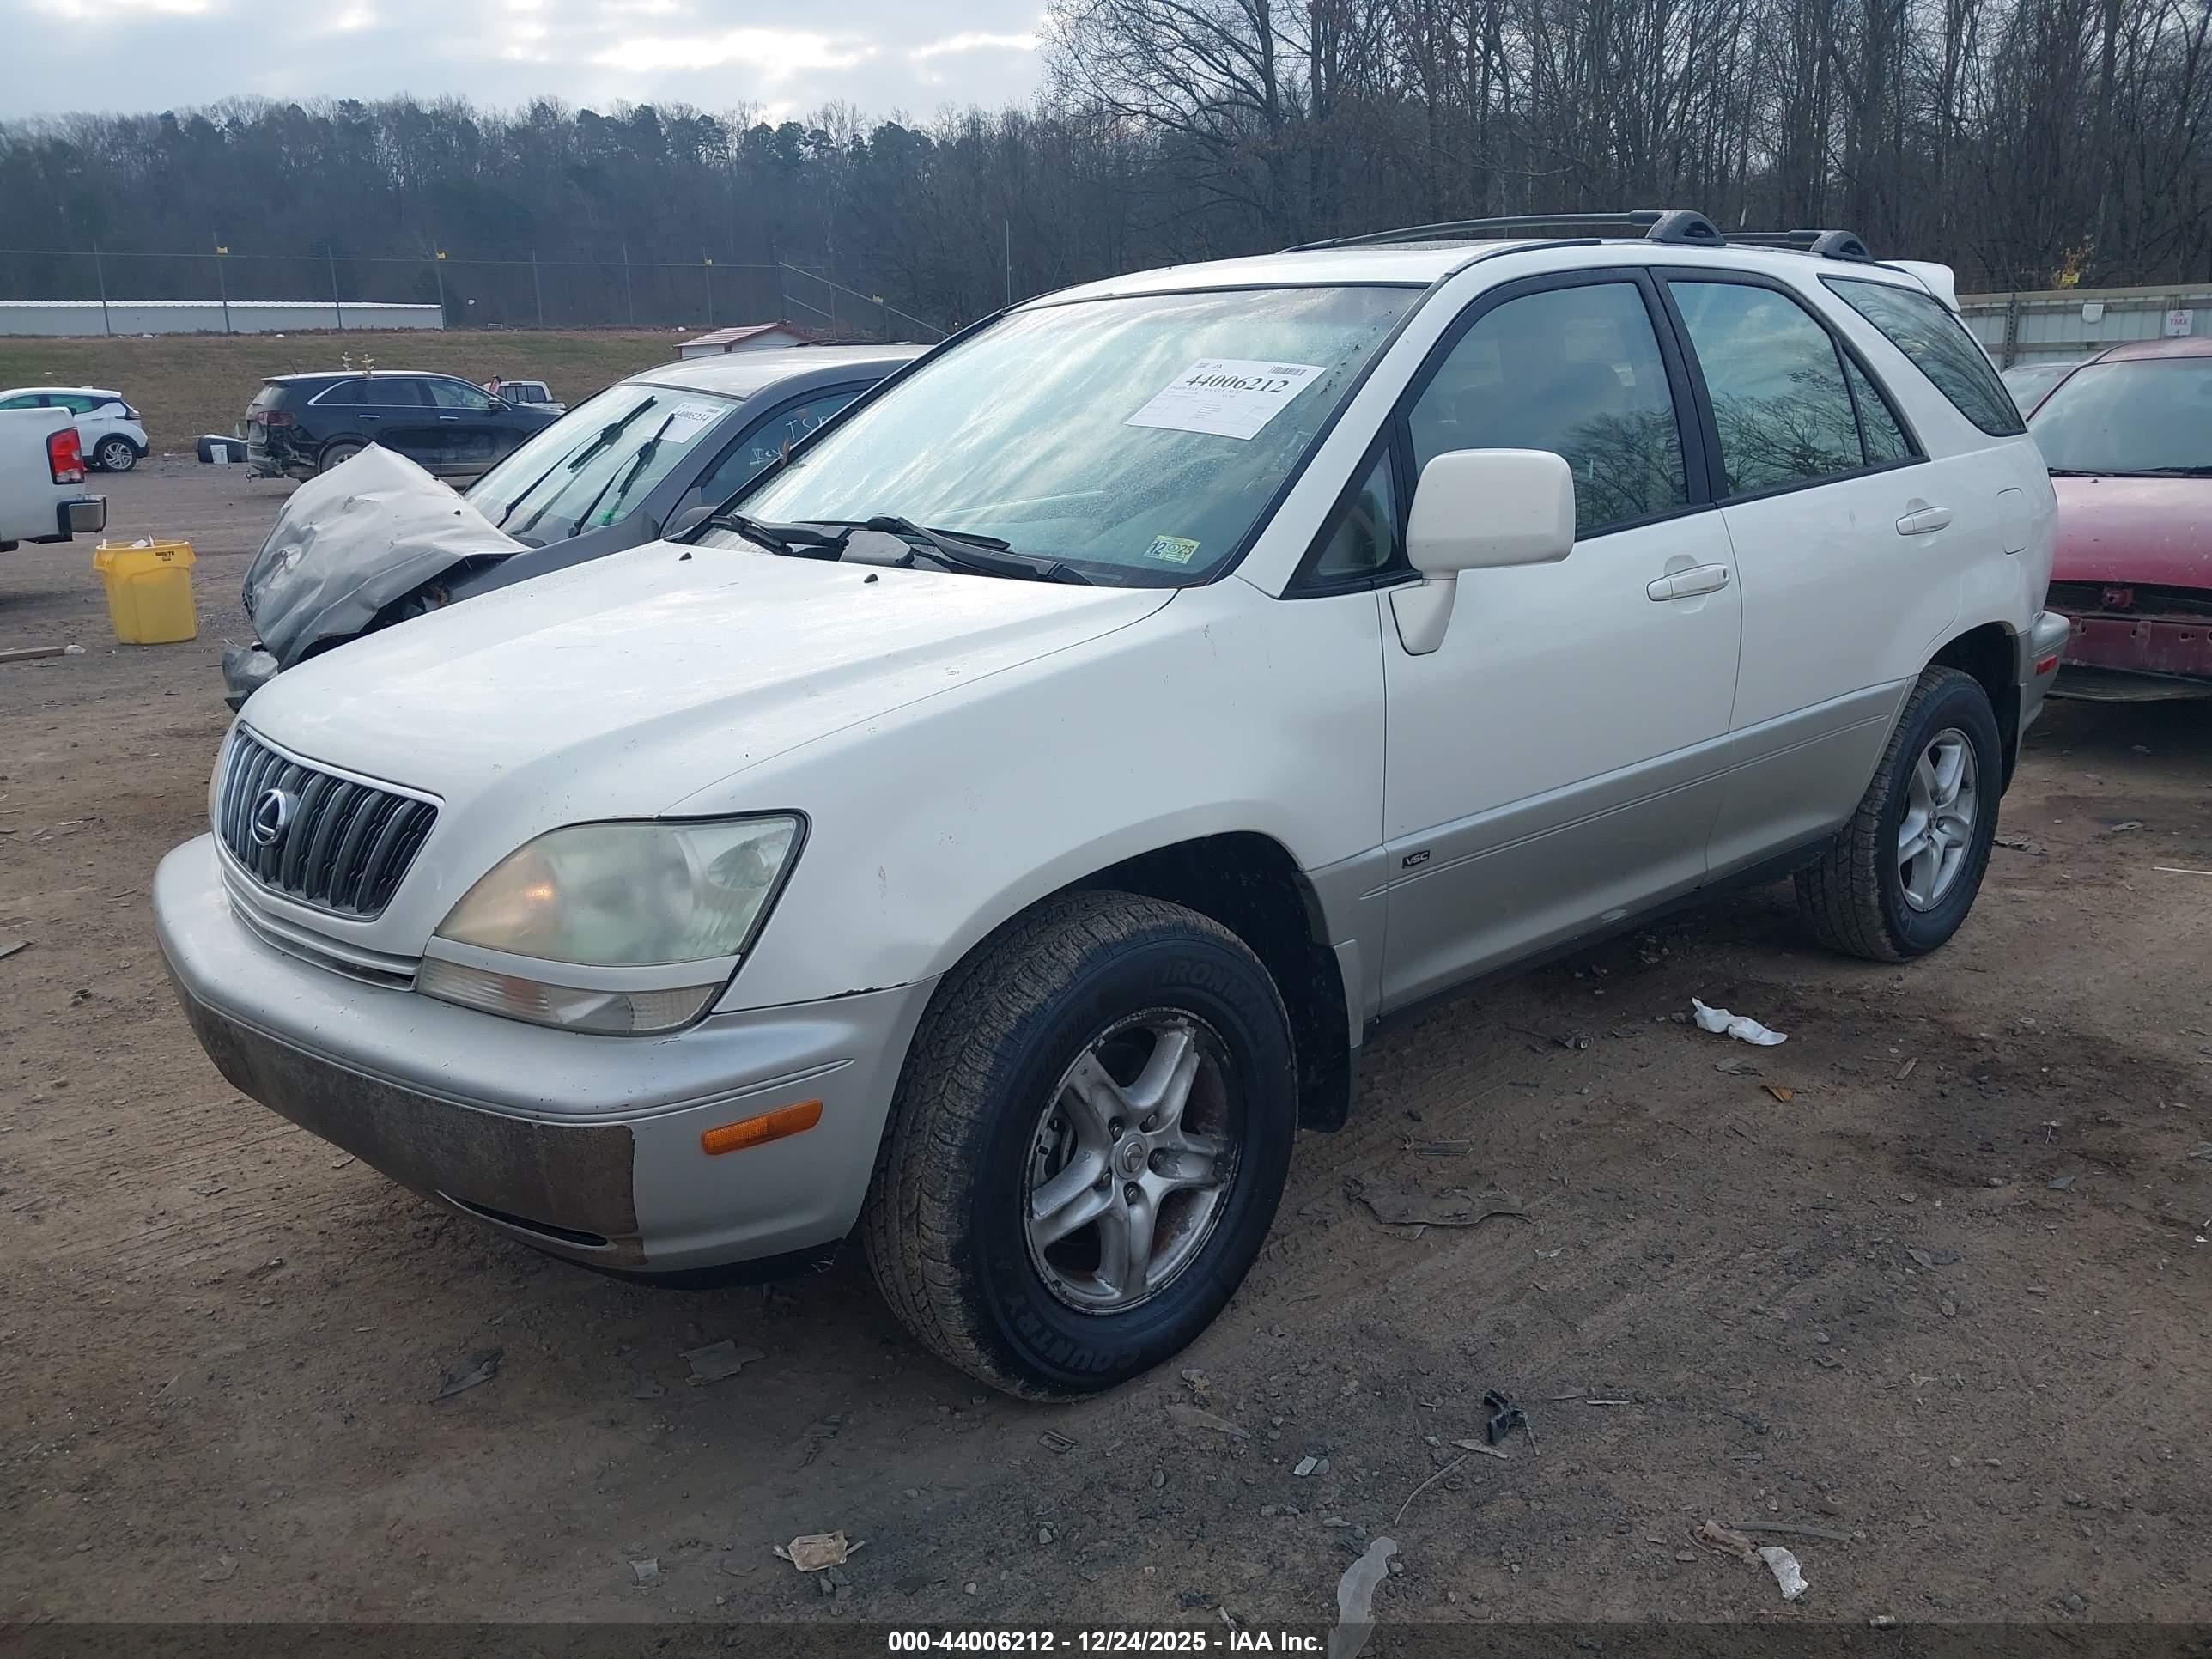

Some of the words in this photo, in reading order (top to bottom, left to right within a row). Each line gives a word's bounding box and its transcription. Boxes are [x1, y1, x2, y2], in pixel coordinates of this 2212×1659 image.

[1186, 373, 1290, 393] 44006212
[1150, 541, 1167, 555] 12
[1406, 851, 1429, 866] VSC
[1004, 1295, 1141, 1372] COUNTRY
